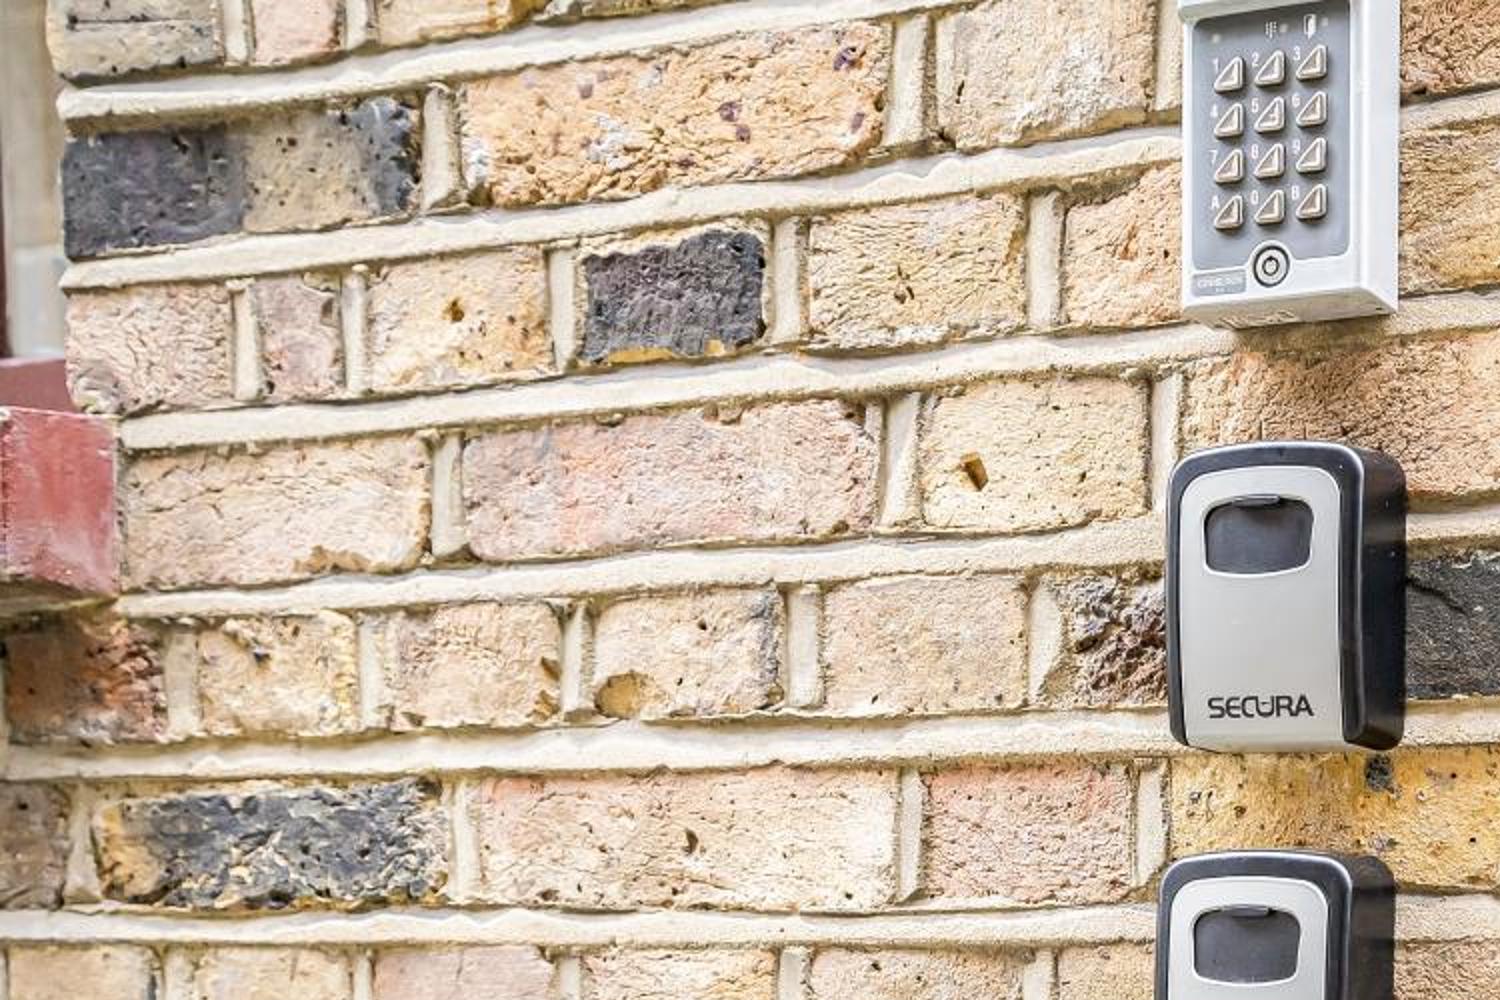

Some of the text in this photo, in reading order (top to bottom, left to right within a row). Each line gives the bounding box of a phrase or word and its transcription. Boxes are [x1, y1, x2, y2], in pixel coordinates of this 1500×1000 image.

[1251, 52, 1260, 67] 2
[1293, 45, 1302, 61] 3
[1251, 97, 1260, 112] 5
[1292, 92, 1301, 107] 6
[1251, 144, 1260, 159] 8
[1292, 140, 1301, 155] 9
[1251, 190, 1260, 205] 0
[1207, 694, 1314, 719] SECURA
